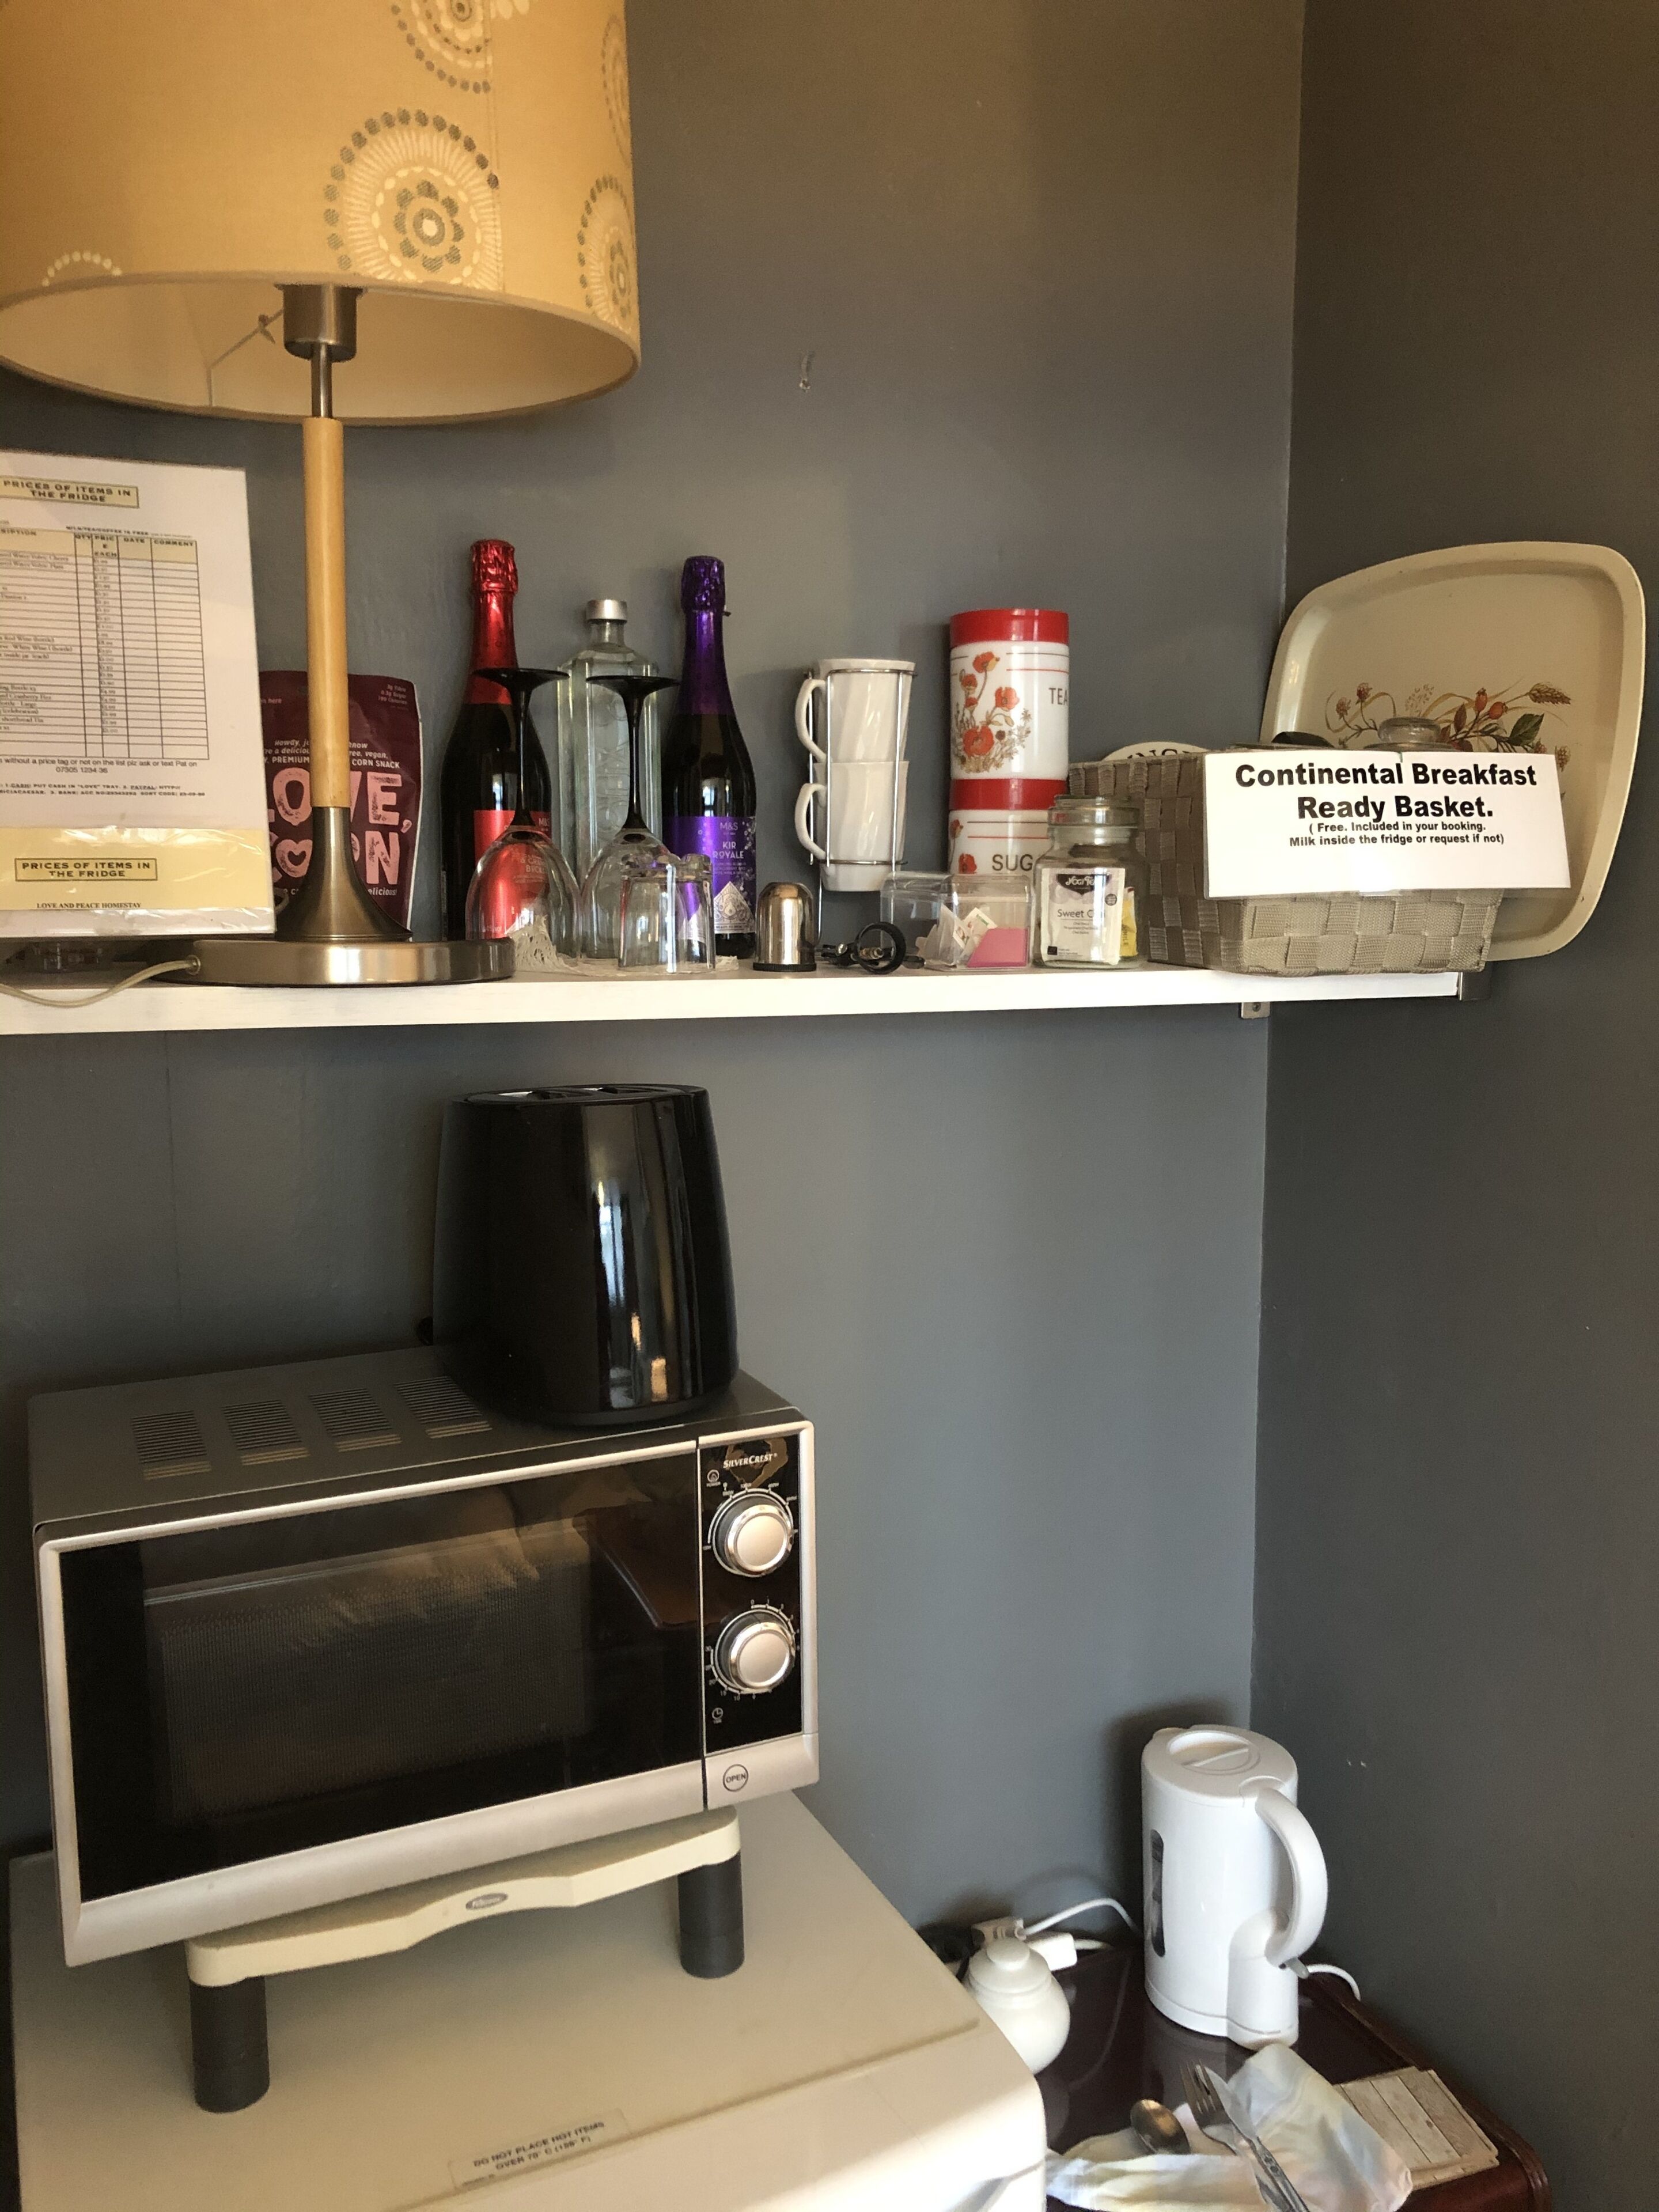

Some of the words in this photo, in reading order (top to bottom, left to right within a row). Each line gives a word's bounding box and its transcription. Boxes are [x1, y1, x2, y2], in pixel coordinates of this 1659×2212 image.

[3, 480, 50, 490] PRICES
[76, 486, 113, 495] ITEMS
[30, 489, 55, 498] THE
[59, 492, 105, 502] FRIDGE
[1049, 687, 1069, 706] TEA
[38, 757, 56, 766] price
[58, 758, 69, 767] tag
[352, 758, 374, 766] CORN
[376, 760, 400, 768] SNACK
[1236, 763, 1403, 787] Continental
[1412, 763, 1537, 785] Breakfast
[1297, 796, 1385, 823] Ready
[1395, 796, 1493, 817] Basket.
[720, 822, 738, 830] M&S
[1317, 823, 1347, 832] Free.
[1351, 822, 1399, 831] Included
[1403, 821, 1412, 830] in
[1415, 823, 1438, 833] your
[1441, 821, 1486, 833] booking.
[722, 841, 737, 849] KIR
[1289, 836, 1316, 847] Milk
[1320, 835, 1355, 845] inside
[1359, 834, 1377, 844] the
[1381, 834, 1413, 845] fridge
[1430, 834, 1469, 845] request
[1473, 834, 1480, 842] if
[1483, 834, 1504, 844] not)
[713, 850, 744, 859] ROYALE
[992, 854, 1033, 872] SUG
[1058, 909, 1084, 918] Sweet
[726, 1773, 747, 1783] OPEN
[474, 2158, 489, 2167] DO
[491, 2150, 513, 2162] NOT
[516, 2138, 548, 2154] PLACE
[551, 2131, 572, 2143] HOT
[574, 2122, 605, 2136] ITEMS
